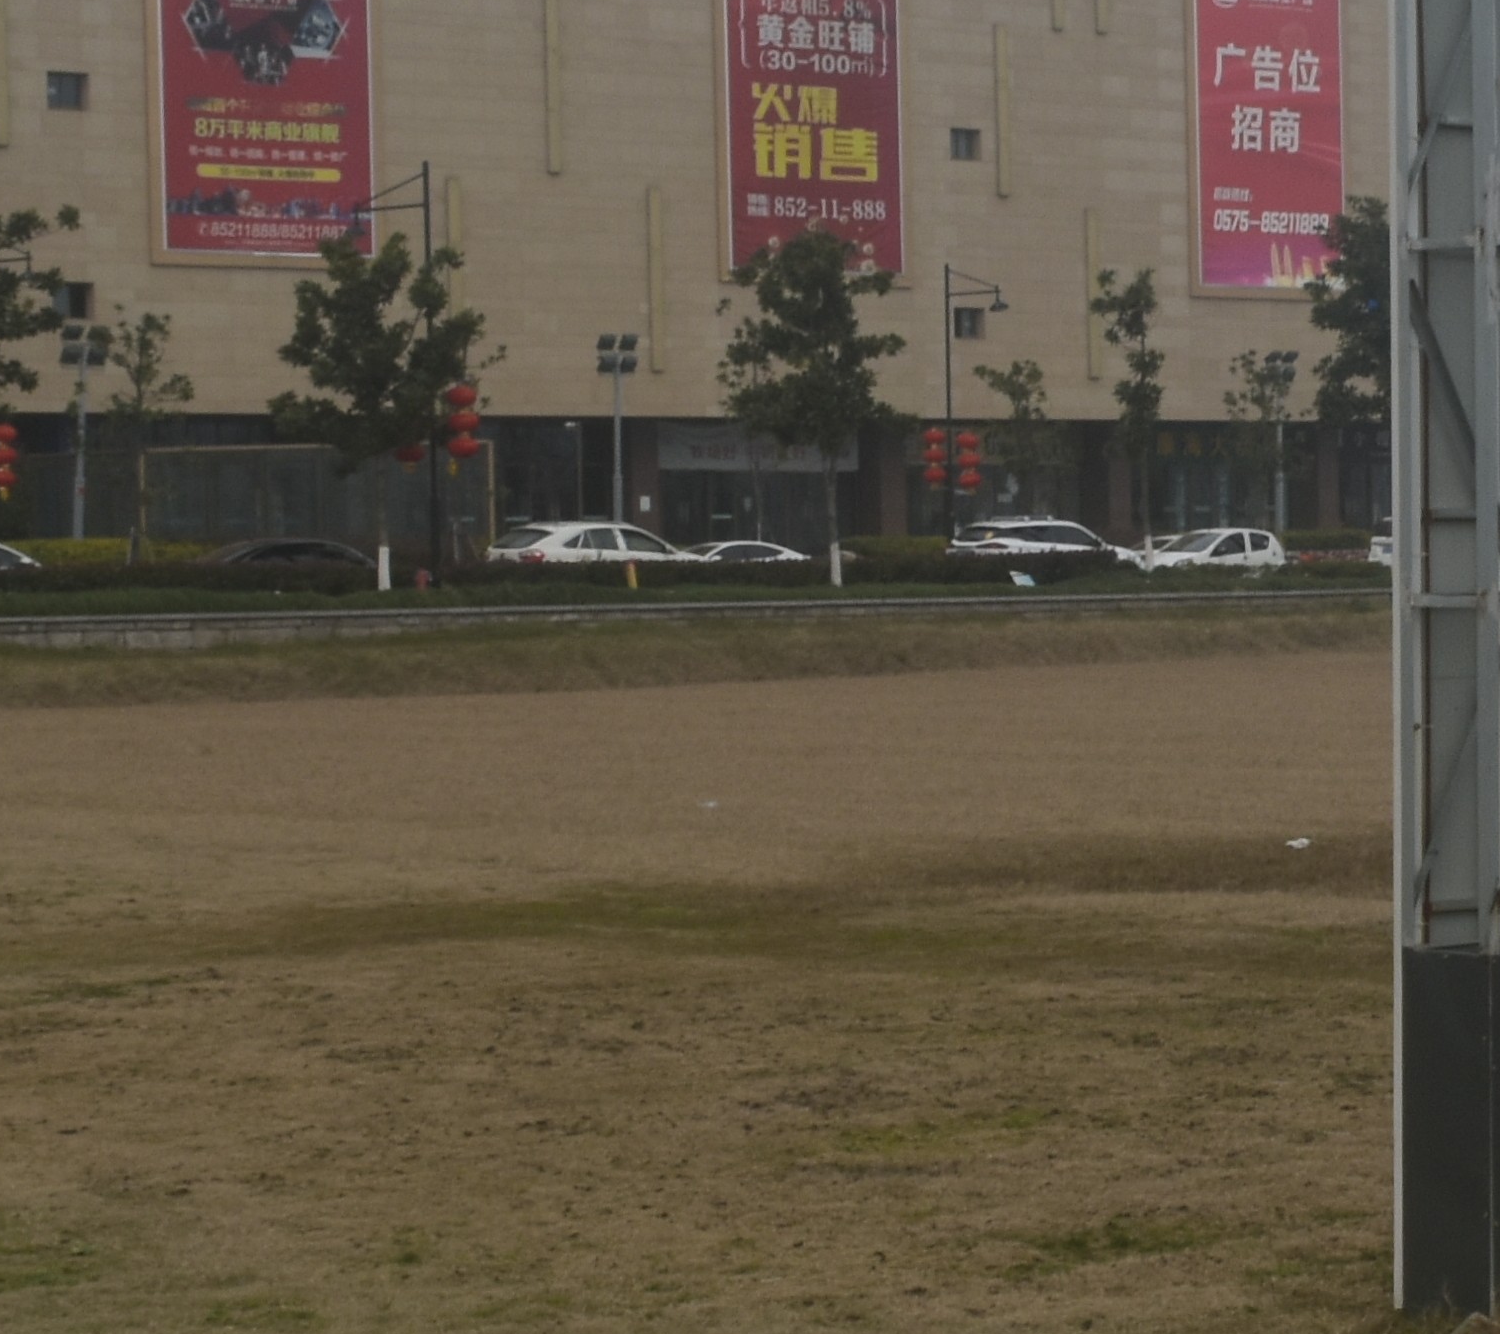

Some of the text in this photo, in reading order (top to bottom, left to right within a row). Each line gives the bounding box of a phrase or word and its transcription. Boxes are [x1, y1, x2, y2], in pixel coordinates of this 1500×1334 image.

[757, 14, 875, 54] 黄金旺铺
[1213, 43, 1321, 93] 广告位
[752, 82, 838, 125] 火爆
[753, 123, 878, 182] 销售
[1231, 105, 1301, 154] 招商
[774, 196, 886, 221] 852-11-888
